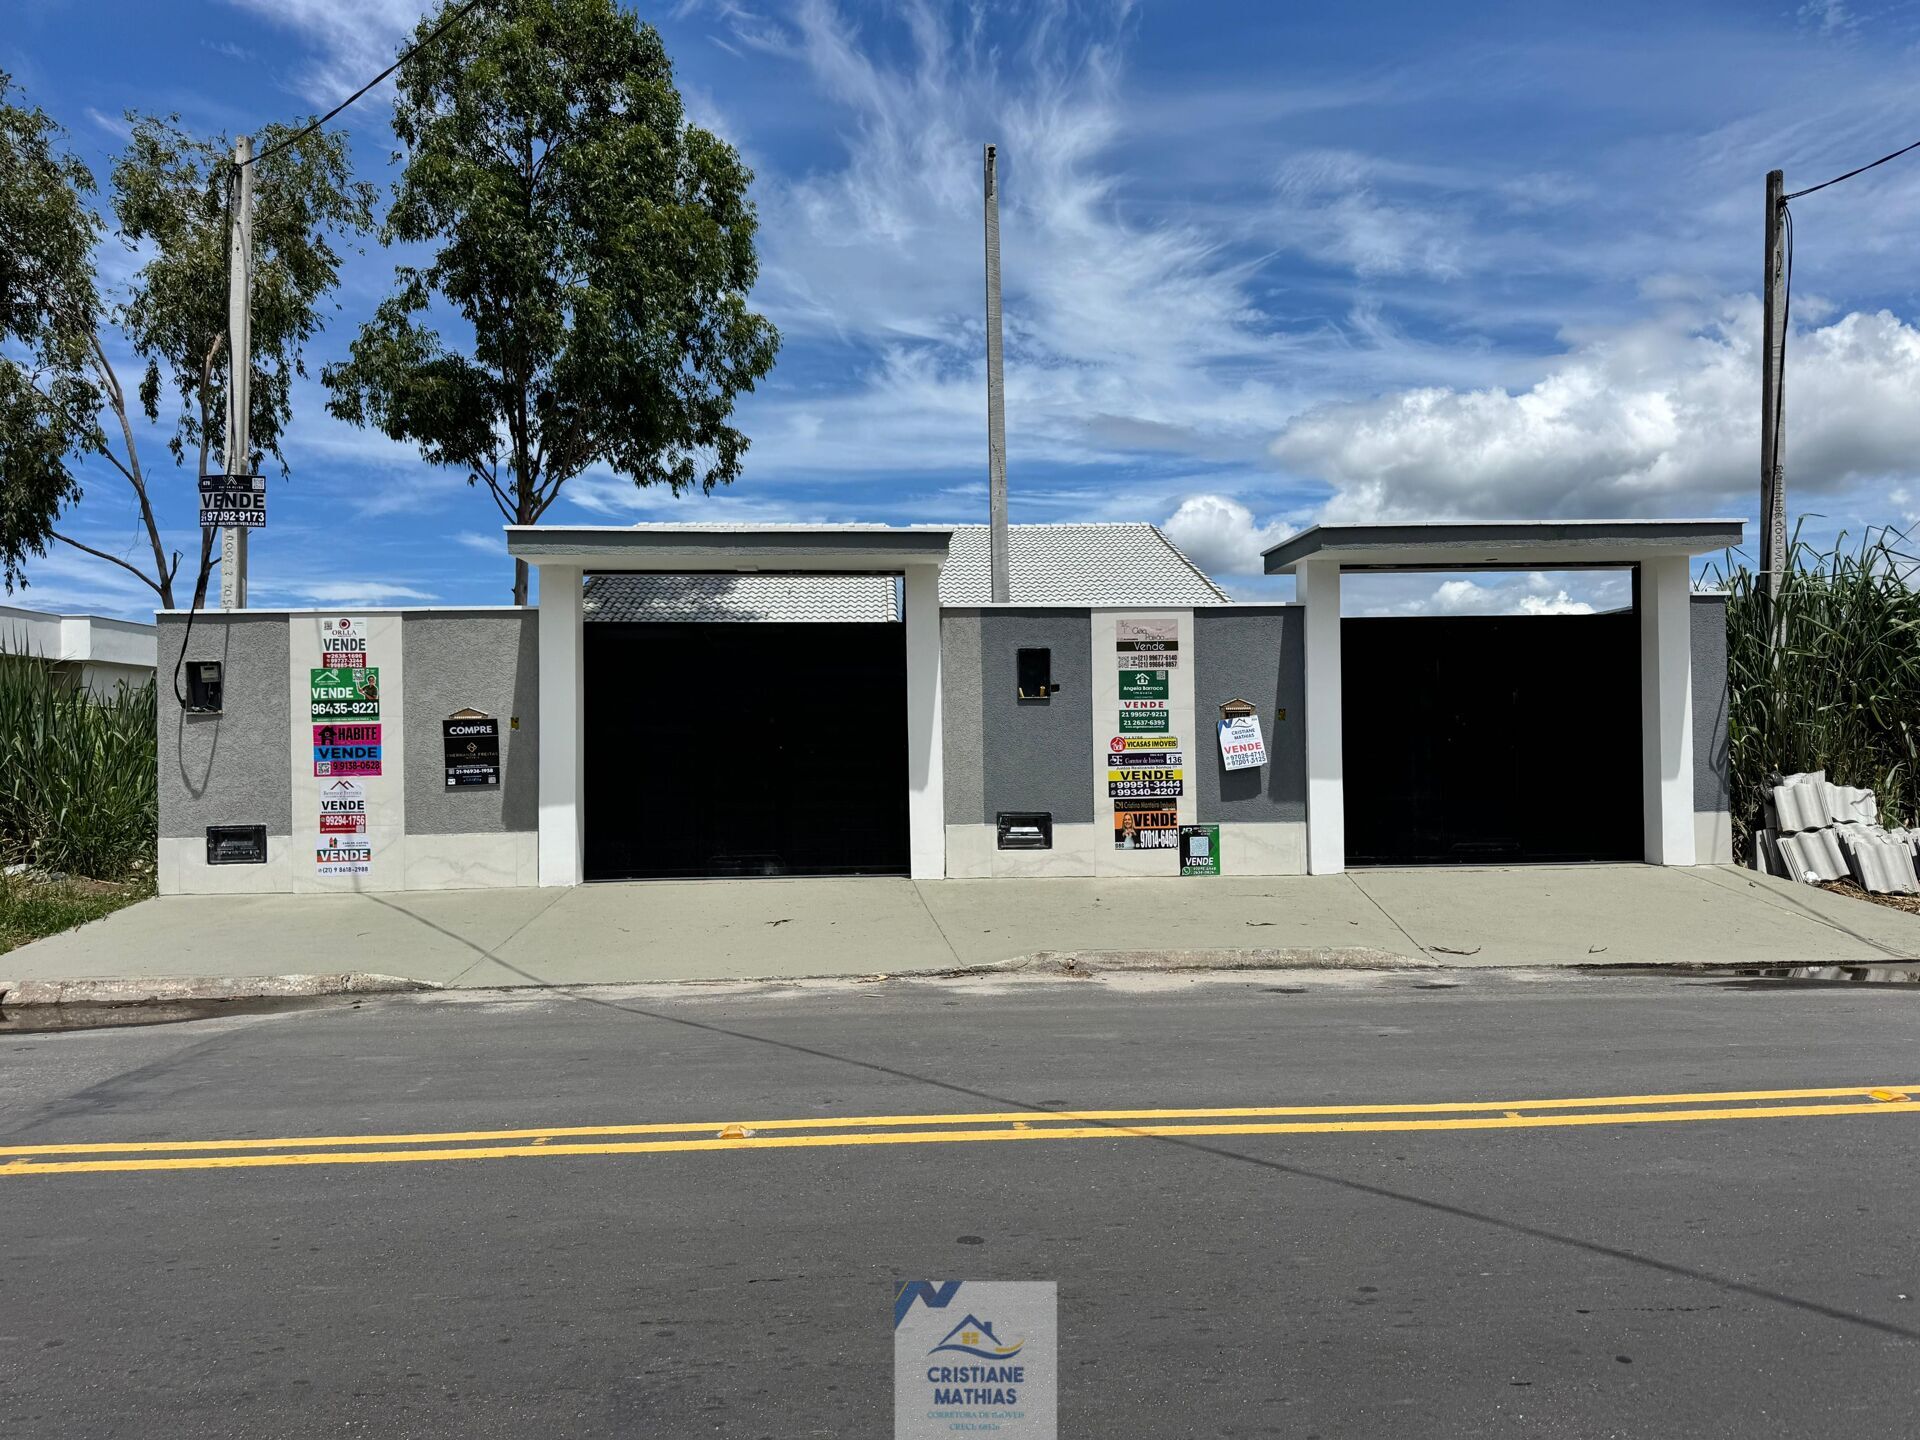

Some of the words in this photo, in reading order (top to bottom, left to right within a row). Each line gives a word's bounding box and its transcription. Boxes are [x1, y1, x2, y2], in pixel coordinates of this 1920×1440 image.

[202, 493, 264, 509] VENDE
[207, 511, 264, 522] 97092-9173
[323, 638, 366, 651] VENDE
[1134, 641, 1165, 651] Vende
[312, 687, 354, 699] VENDE
[312, 702, 379, 715] 96435-9221
[338, 727, 377, 741] HABITE
[449, 725, 493, 735] COMPRE
[1231, 728, 1256, 736] CRISTIANE
[318, 746, 378, 759] VENDE
[1224, 741, 1262, 755] VENDE
[1168, 756, 1182, 764] 136
[333, 762, 338, 771] 9
[1120, 770, 1174, 780] VENDE
[1117, 780, 1181, 788] 99951-3444
[1117, 787, 1180, 796] 99340-4207
[321, 800, 365, 811] VENDE
[325, 815, 365, 826] 99294-1756
[1133, 812, 1177, 827] VENDE
[1140, 830, 1178, 848] 97014-6466
[320, 849, 369, 863] VENDE
[1185, 857, 1214, 866] VENDE
